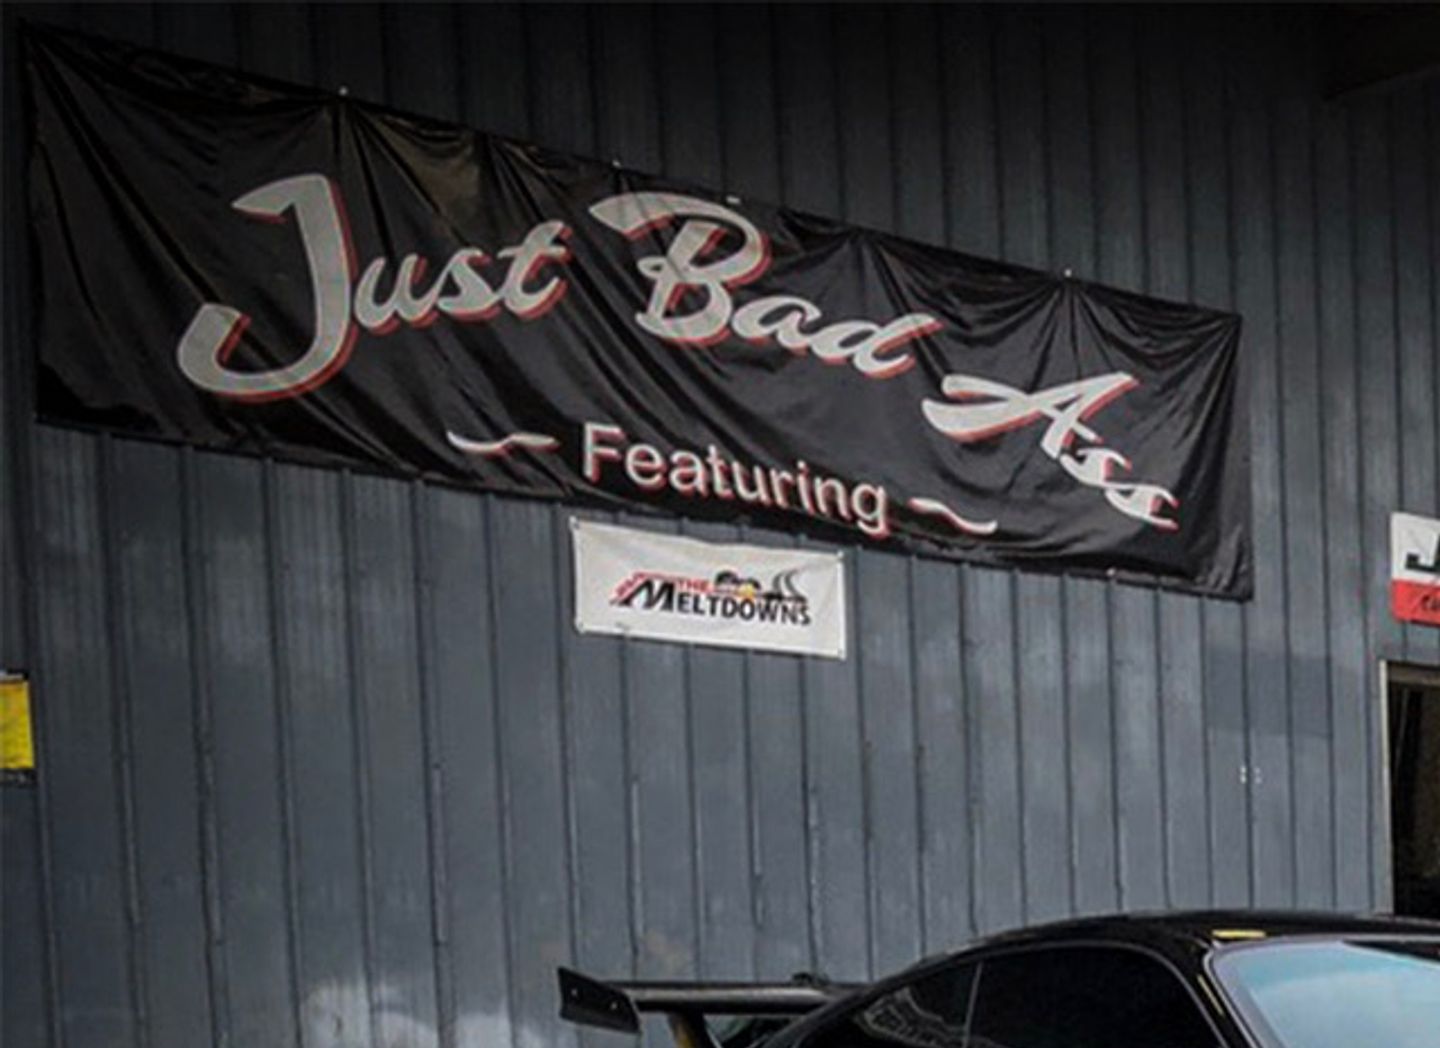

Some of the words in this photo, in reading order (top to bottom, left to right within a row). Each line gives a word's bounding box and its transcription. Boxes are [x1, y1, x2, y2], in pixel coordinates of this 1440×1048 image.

[177, 174, 573, 403] Just
[589, 191, 944, 379] Bad
[921, 371, 1179, 533] Ass
[583, 422, 890, 538] Featuring
[617, 579, 812, 625] MELTDOWNS
